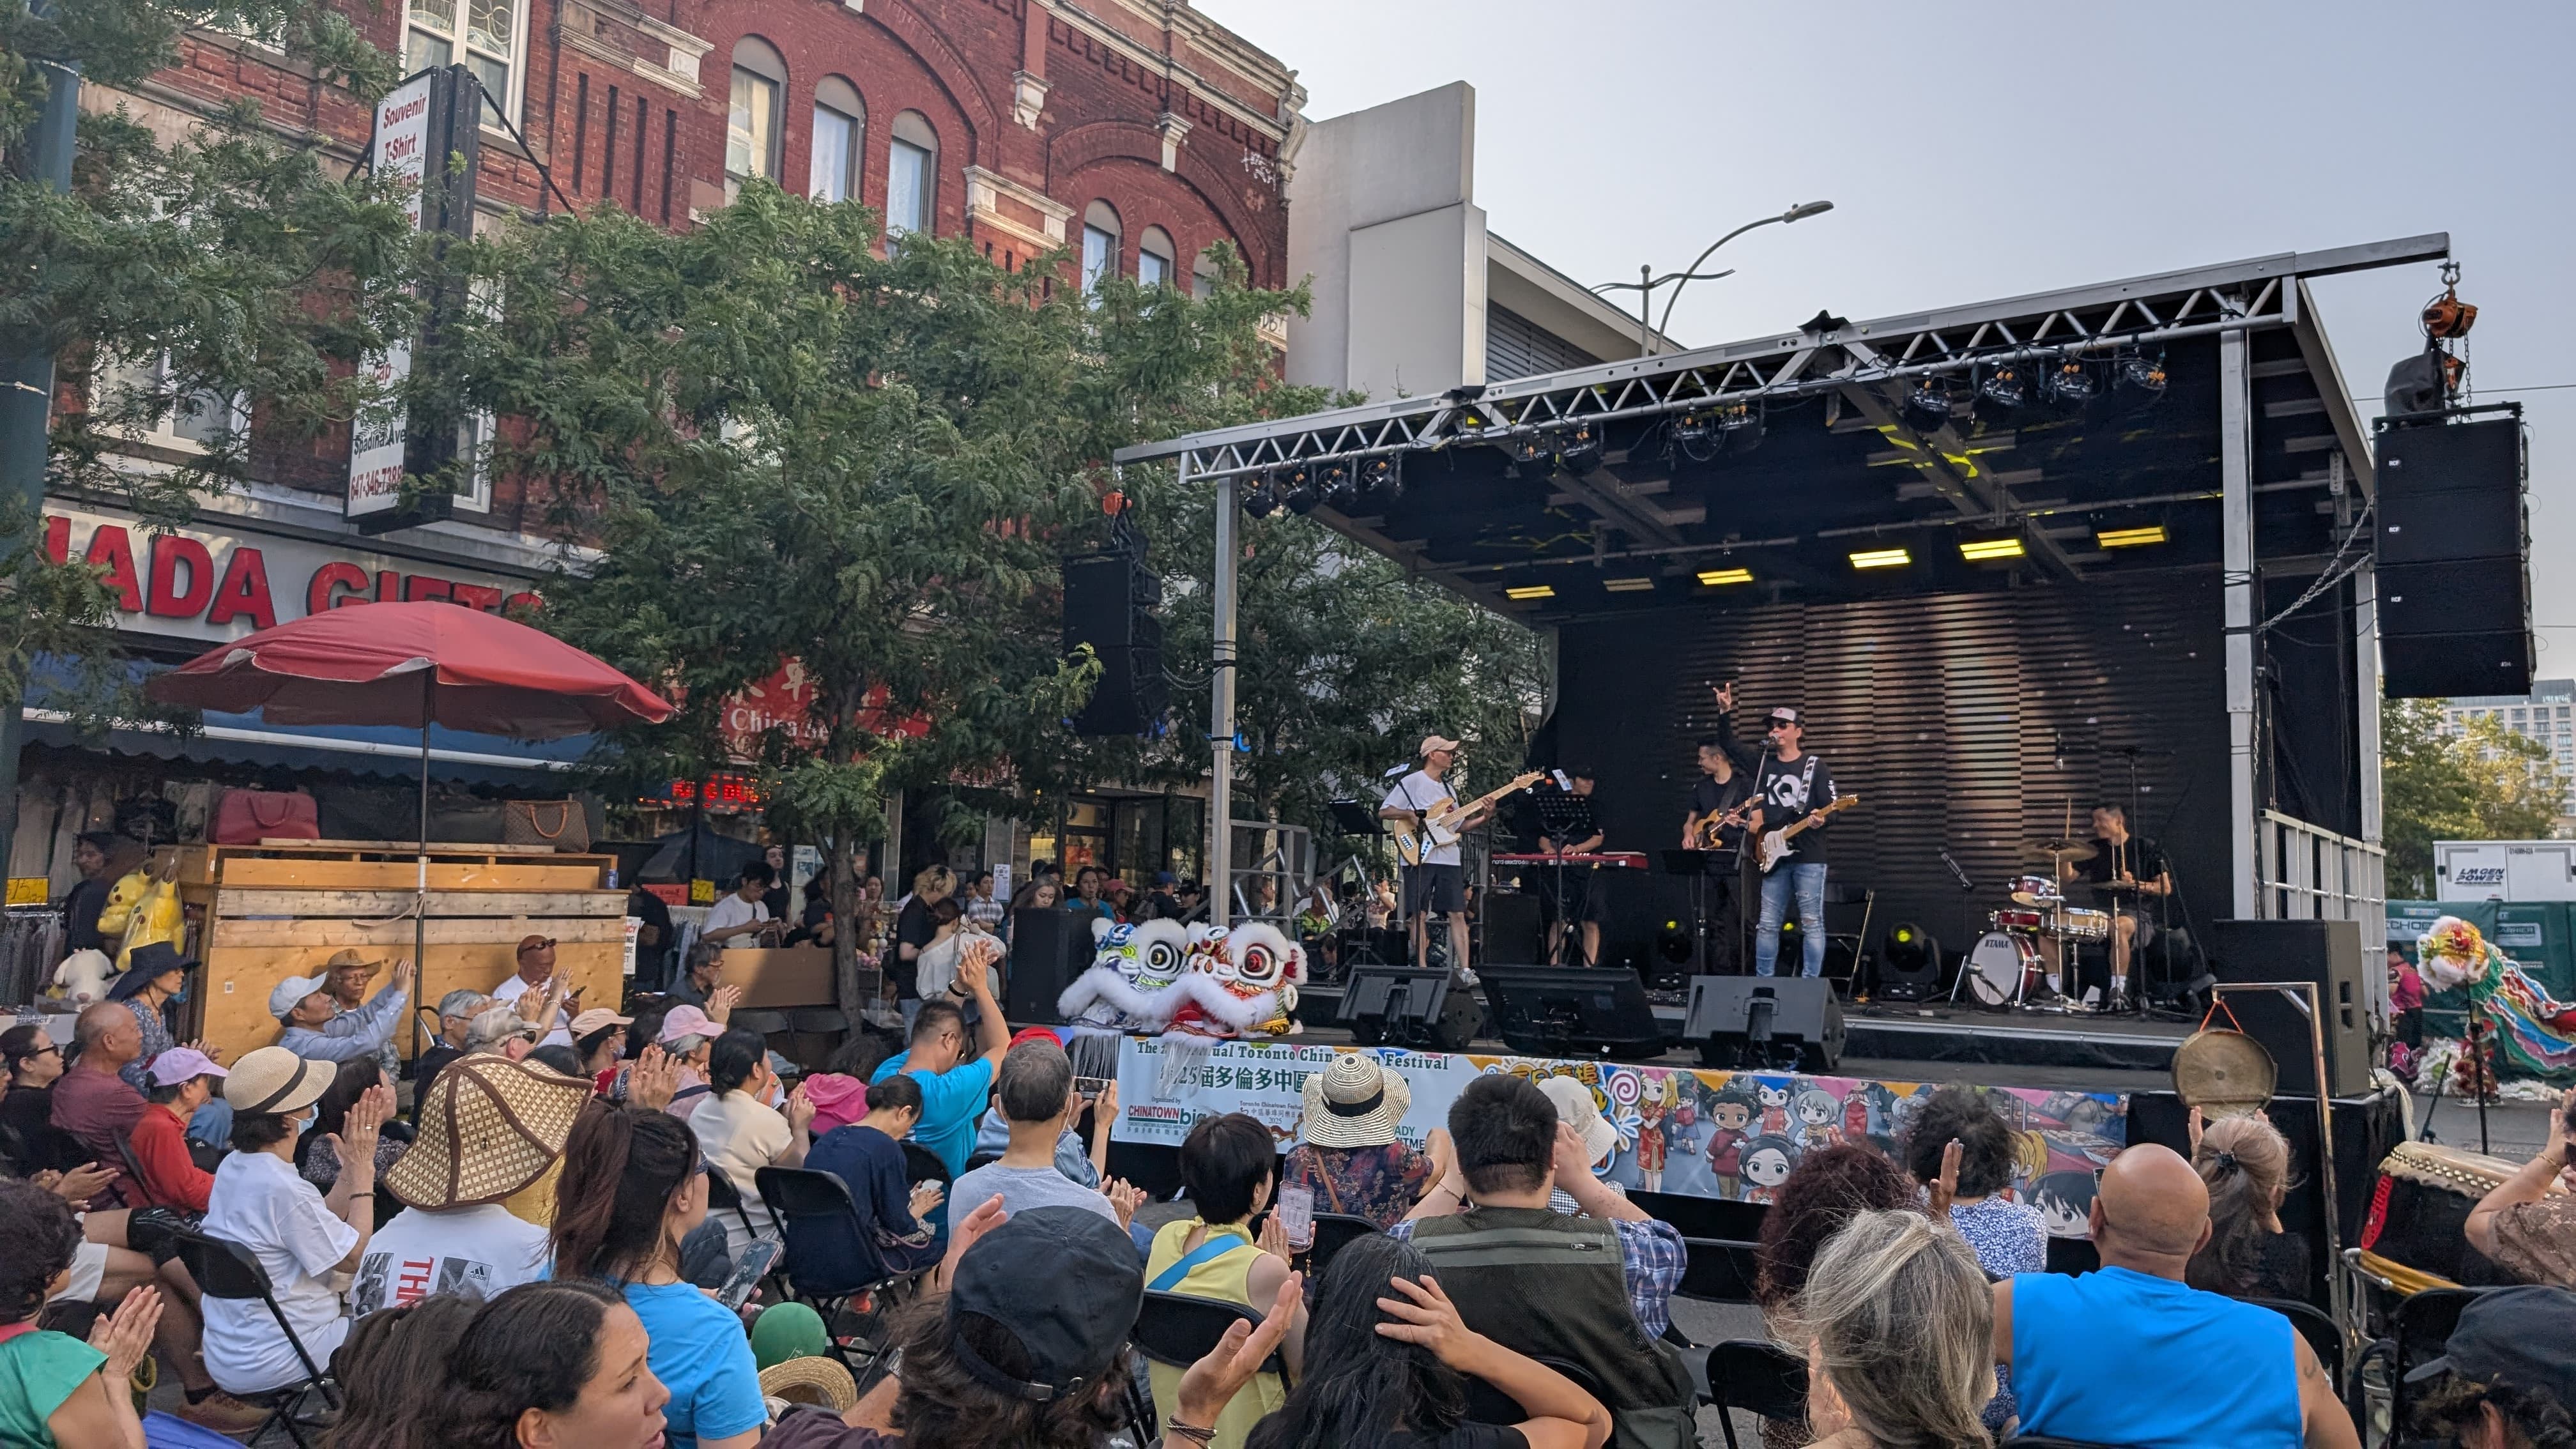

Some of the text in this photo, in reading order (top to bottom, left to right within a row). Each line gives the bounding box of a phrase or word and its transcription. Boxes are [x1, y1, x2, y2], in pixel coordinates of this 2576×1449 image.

[383, 93, 426, 129] Souvenir
[385, 132, 417, 160] T-Shirt
[354, 423, 406, 459] Spadina Ave
[1137, 1041, 1158, 1054] The
[1238, 1045, 1295, 1061] Toronto
[1300, 1048, 1380, 1066] Chinn
[1385, 1053, 1449, 1070] Festival
[1395, 1125, 1416, 1137] ADY
